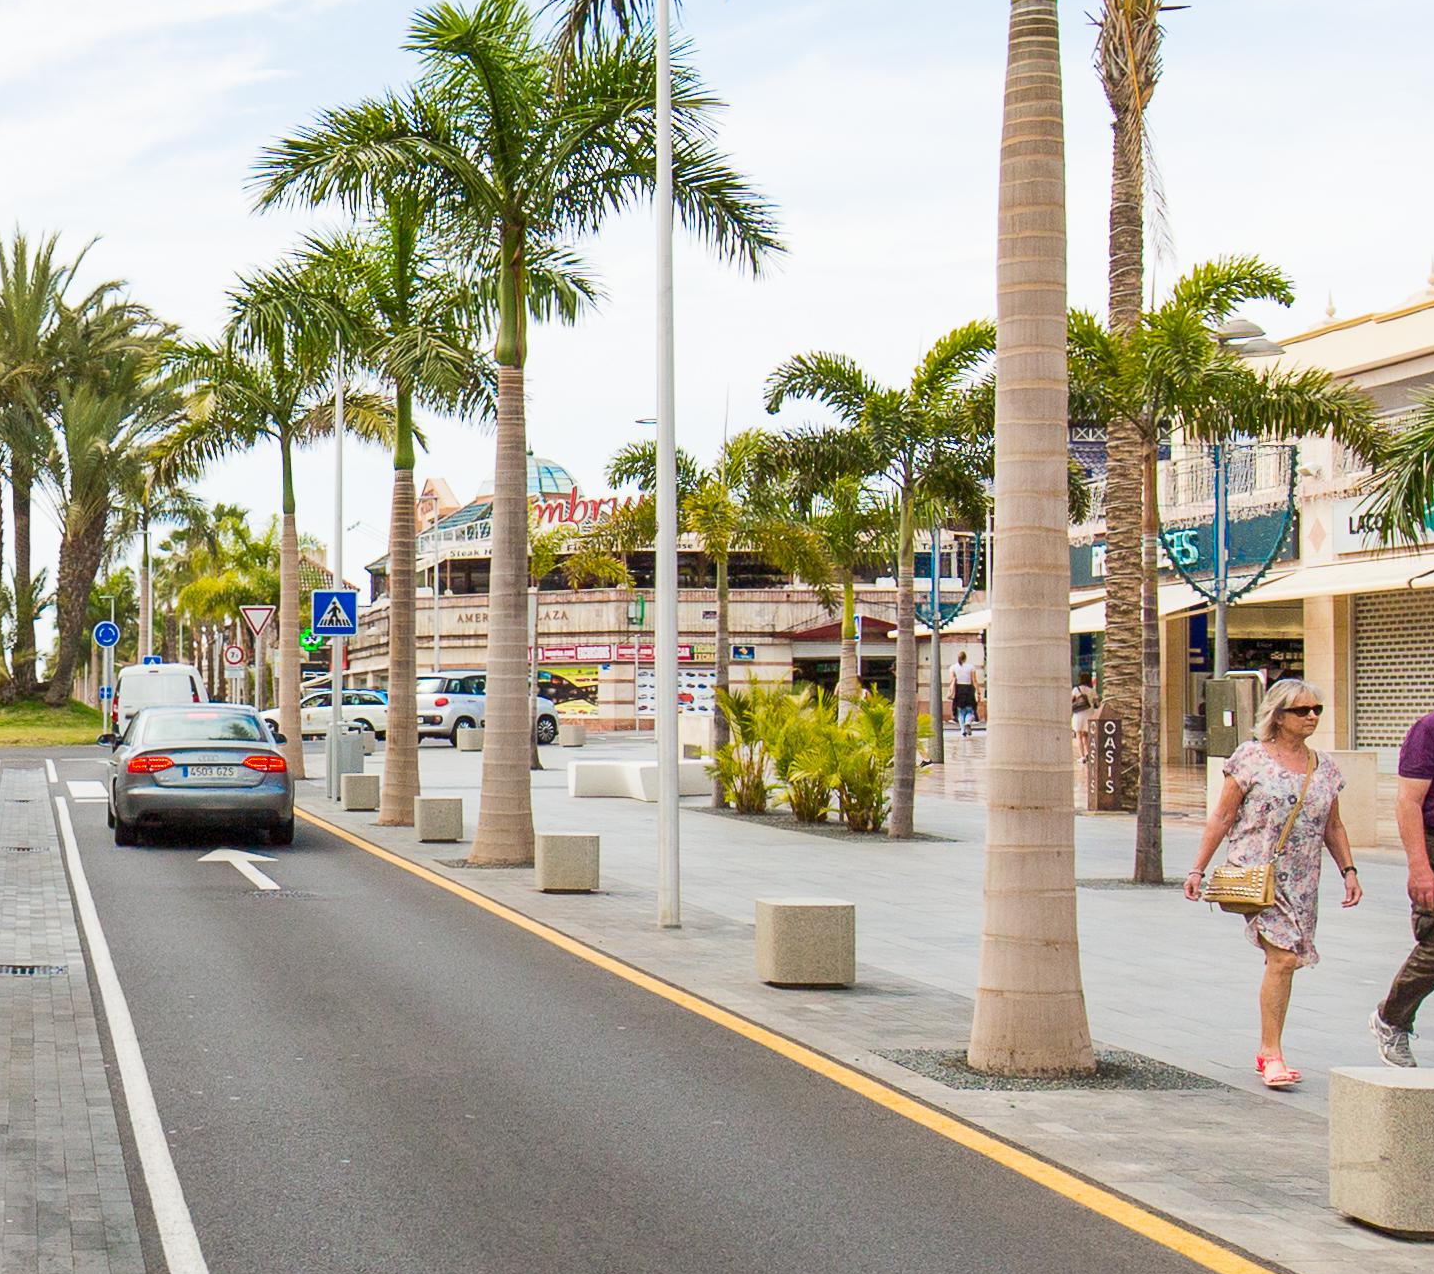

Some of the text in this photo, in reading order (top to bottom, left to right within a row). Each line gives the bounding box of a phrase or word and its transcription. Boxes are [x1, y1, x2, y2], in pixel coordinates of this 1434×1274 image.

[457, 610, 569, 624] AMER AZA
[1103, 720, 1117, 795] OASIS
